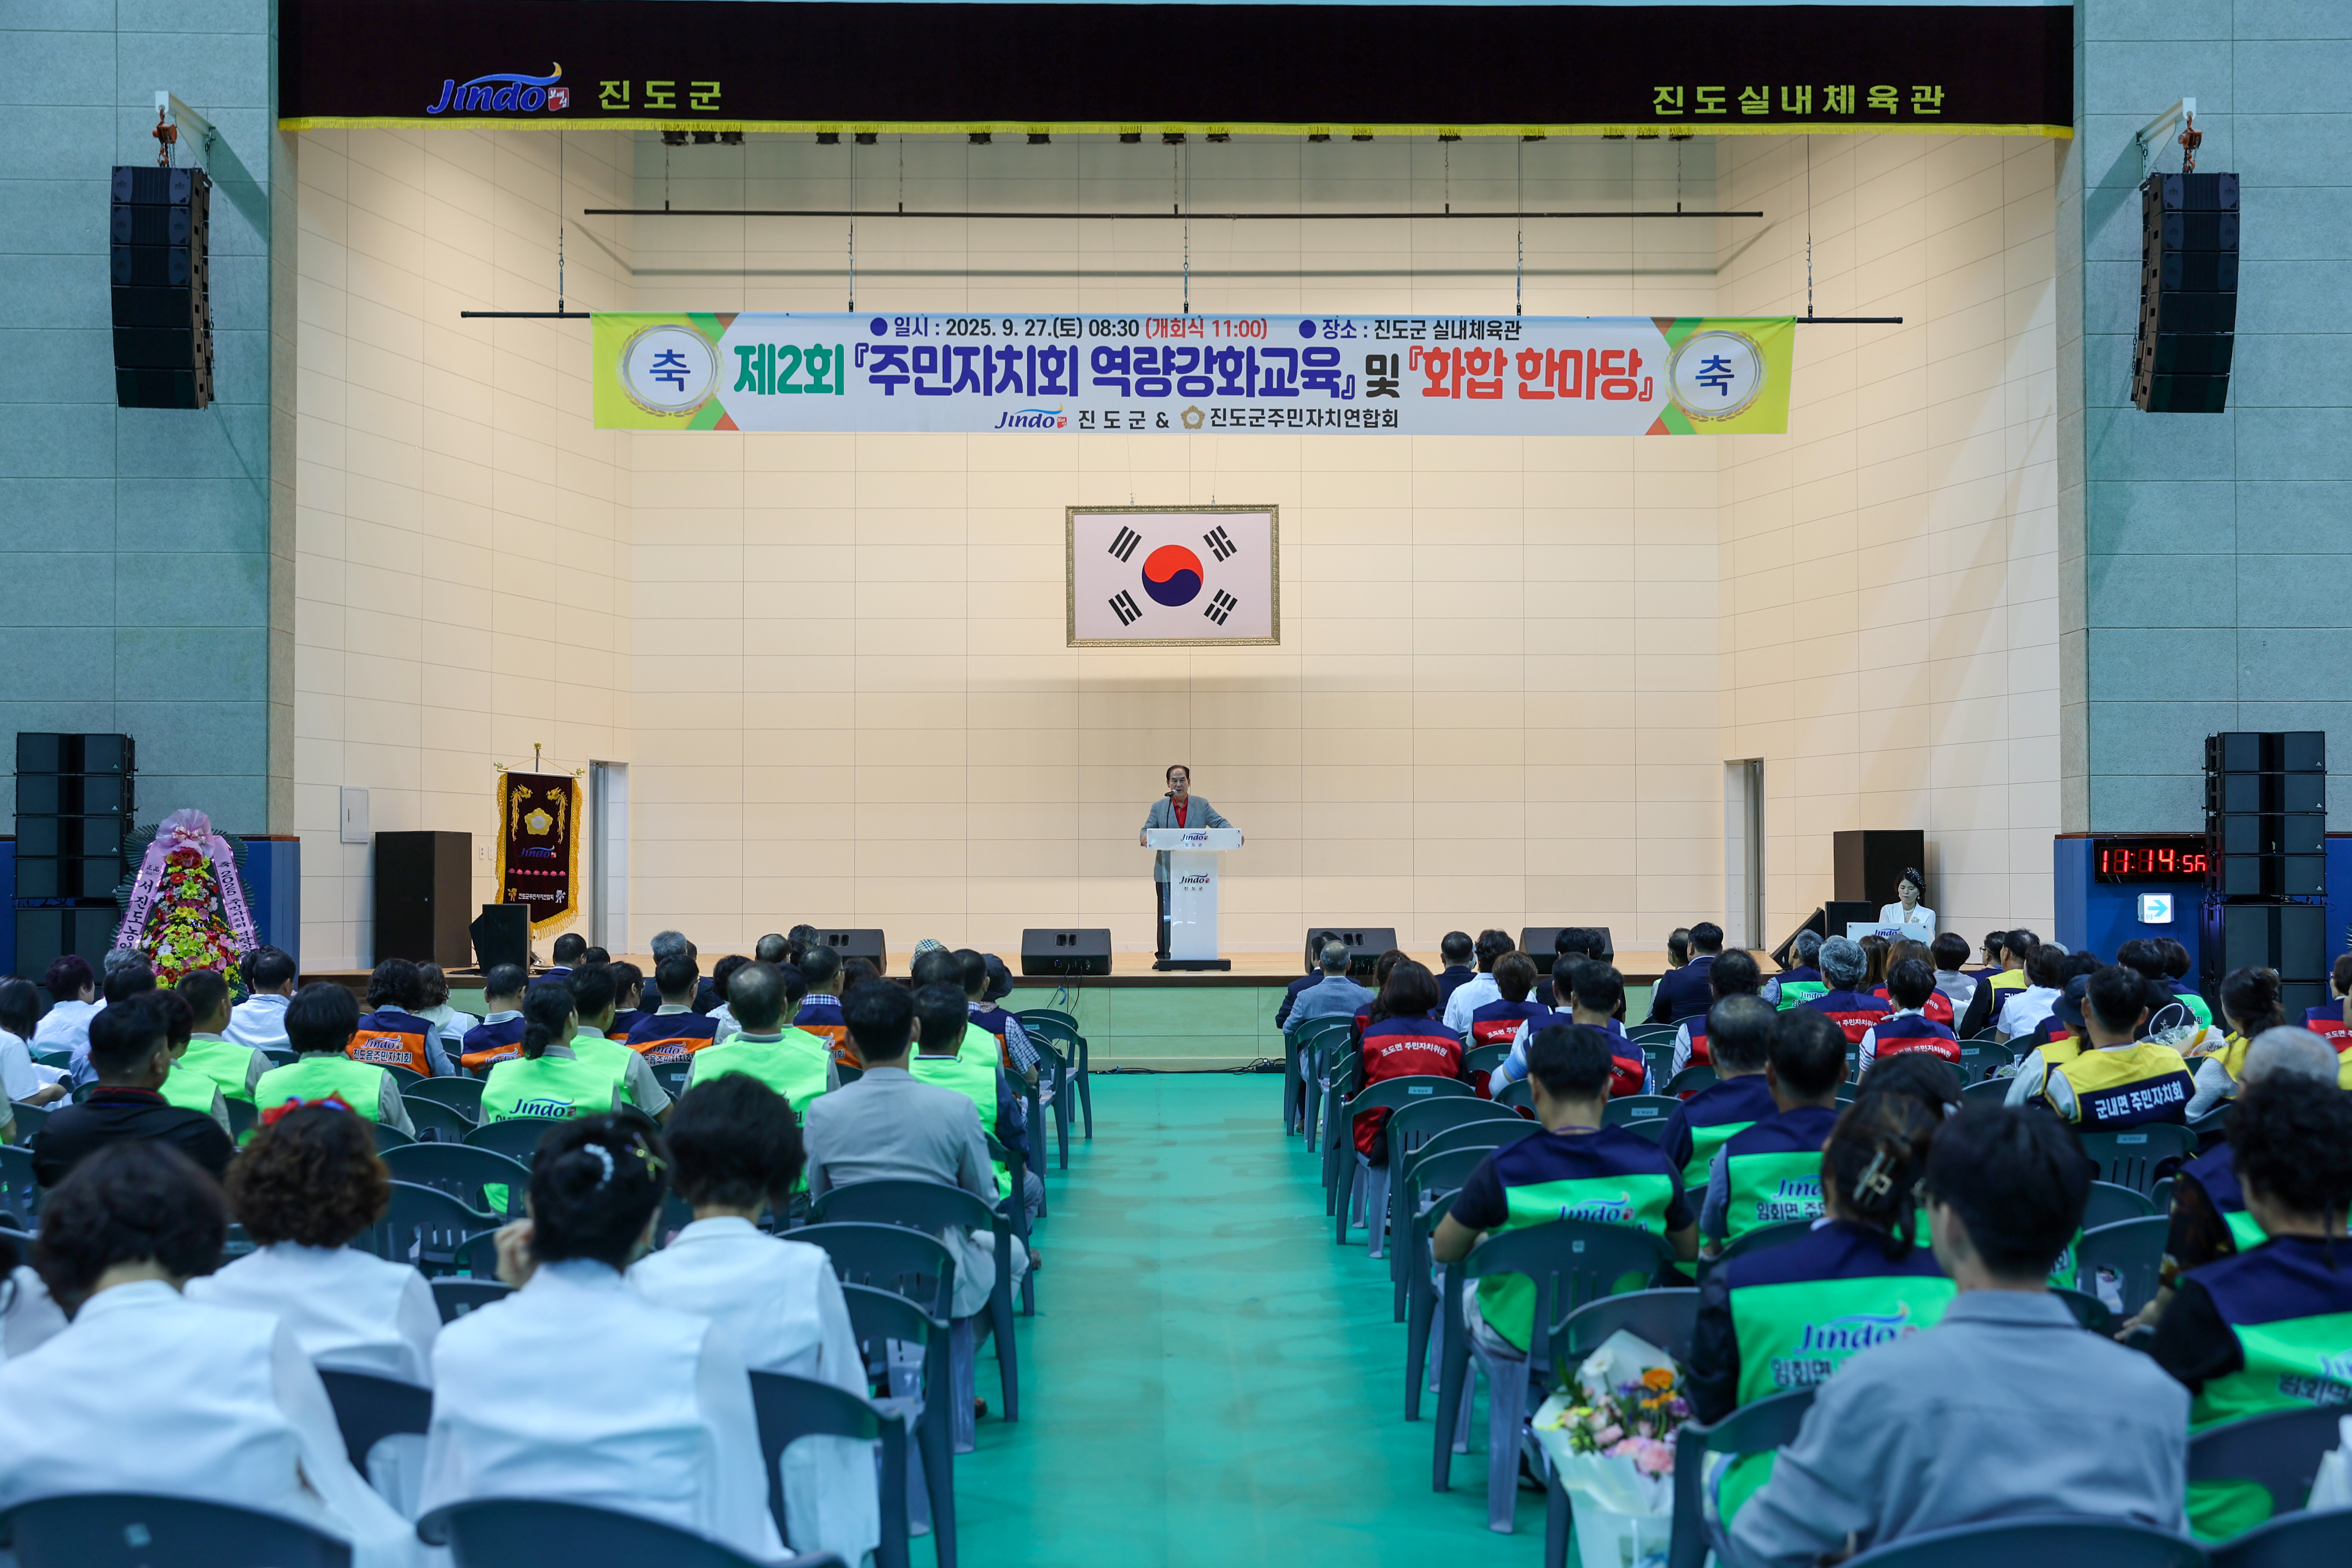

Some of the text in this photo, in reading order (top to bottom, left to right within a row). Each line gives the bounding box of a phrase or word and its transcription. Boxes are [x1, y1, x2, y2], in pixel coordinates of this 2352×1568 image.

[427, 79, 546, 114] Jindo
[598, 80, 722, 110] 진도군
[1652, 85, 1945, 115] 진도실내체육관
[894, 317, 928, 337] 일시
[946, 319, 996, 336] 2025.
[1002, 319, 1018, 336] 9.
[1089, 319, 1140, 337] 08:30
[1145, 318, 1204, 339] (개회식
[1212, 318, 1268, 339] 11:00)
[1322, 319, 1357, 339] 장소
[1374, 320, 1427, 340] 진도군
[1433, 320, 1522, 341] 실내체육관
[649, 349, 691, 392] 축
[733, 343, 1653, 401] 제2회 『주민자치회 역량강화교육』 및 『화합 한마당』
[1695, 355, 1735, 396] 축
[994, 412, 1055, 429] Jindo
[1078, 410, 1146, 430] 진도군
[1156, 412, 1170, 428] &
[1210, 408, 1398, 428] 진도군주민자치연합회
[518, 848, 550, 858] Jindo
[221, 870, 236, 896] 2025
[361, 1038, 395, 1049] Jindo
[2324, 1030, 2347, 1039] 조도면
[353, 1049, 412, 1063] 진도읍주민자치회
[1381, 1042, 1447, 1057] 조도면 주민자치위원
[510, 1099, 565, 1117] Jindo
[2094, 1080, 2185, 1120] 군내면 주민자치회
